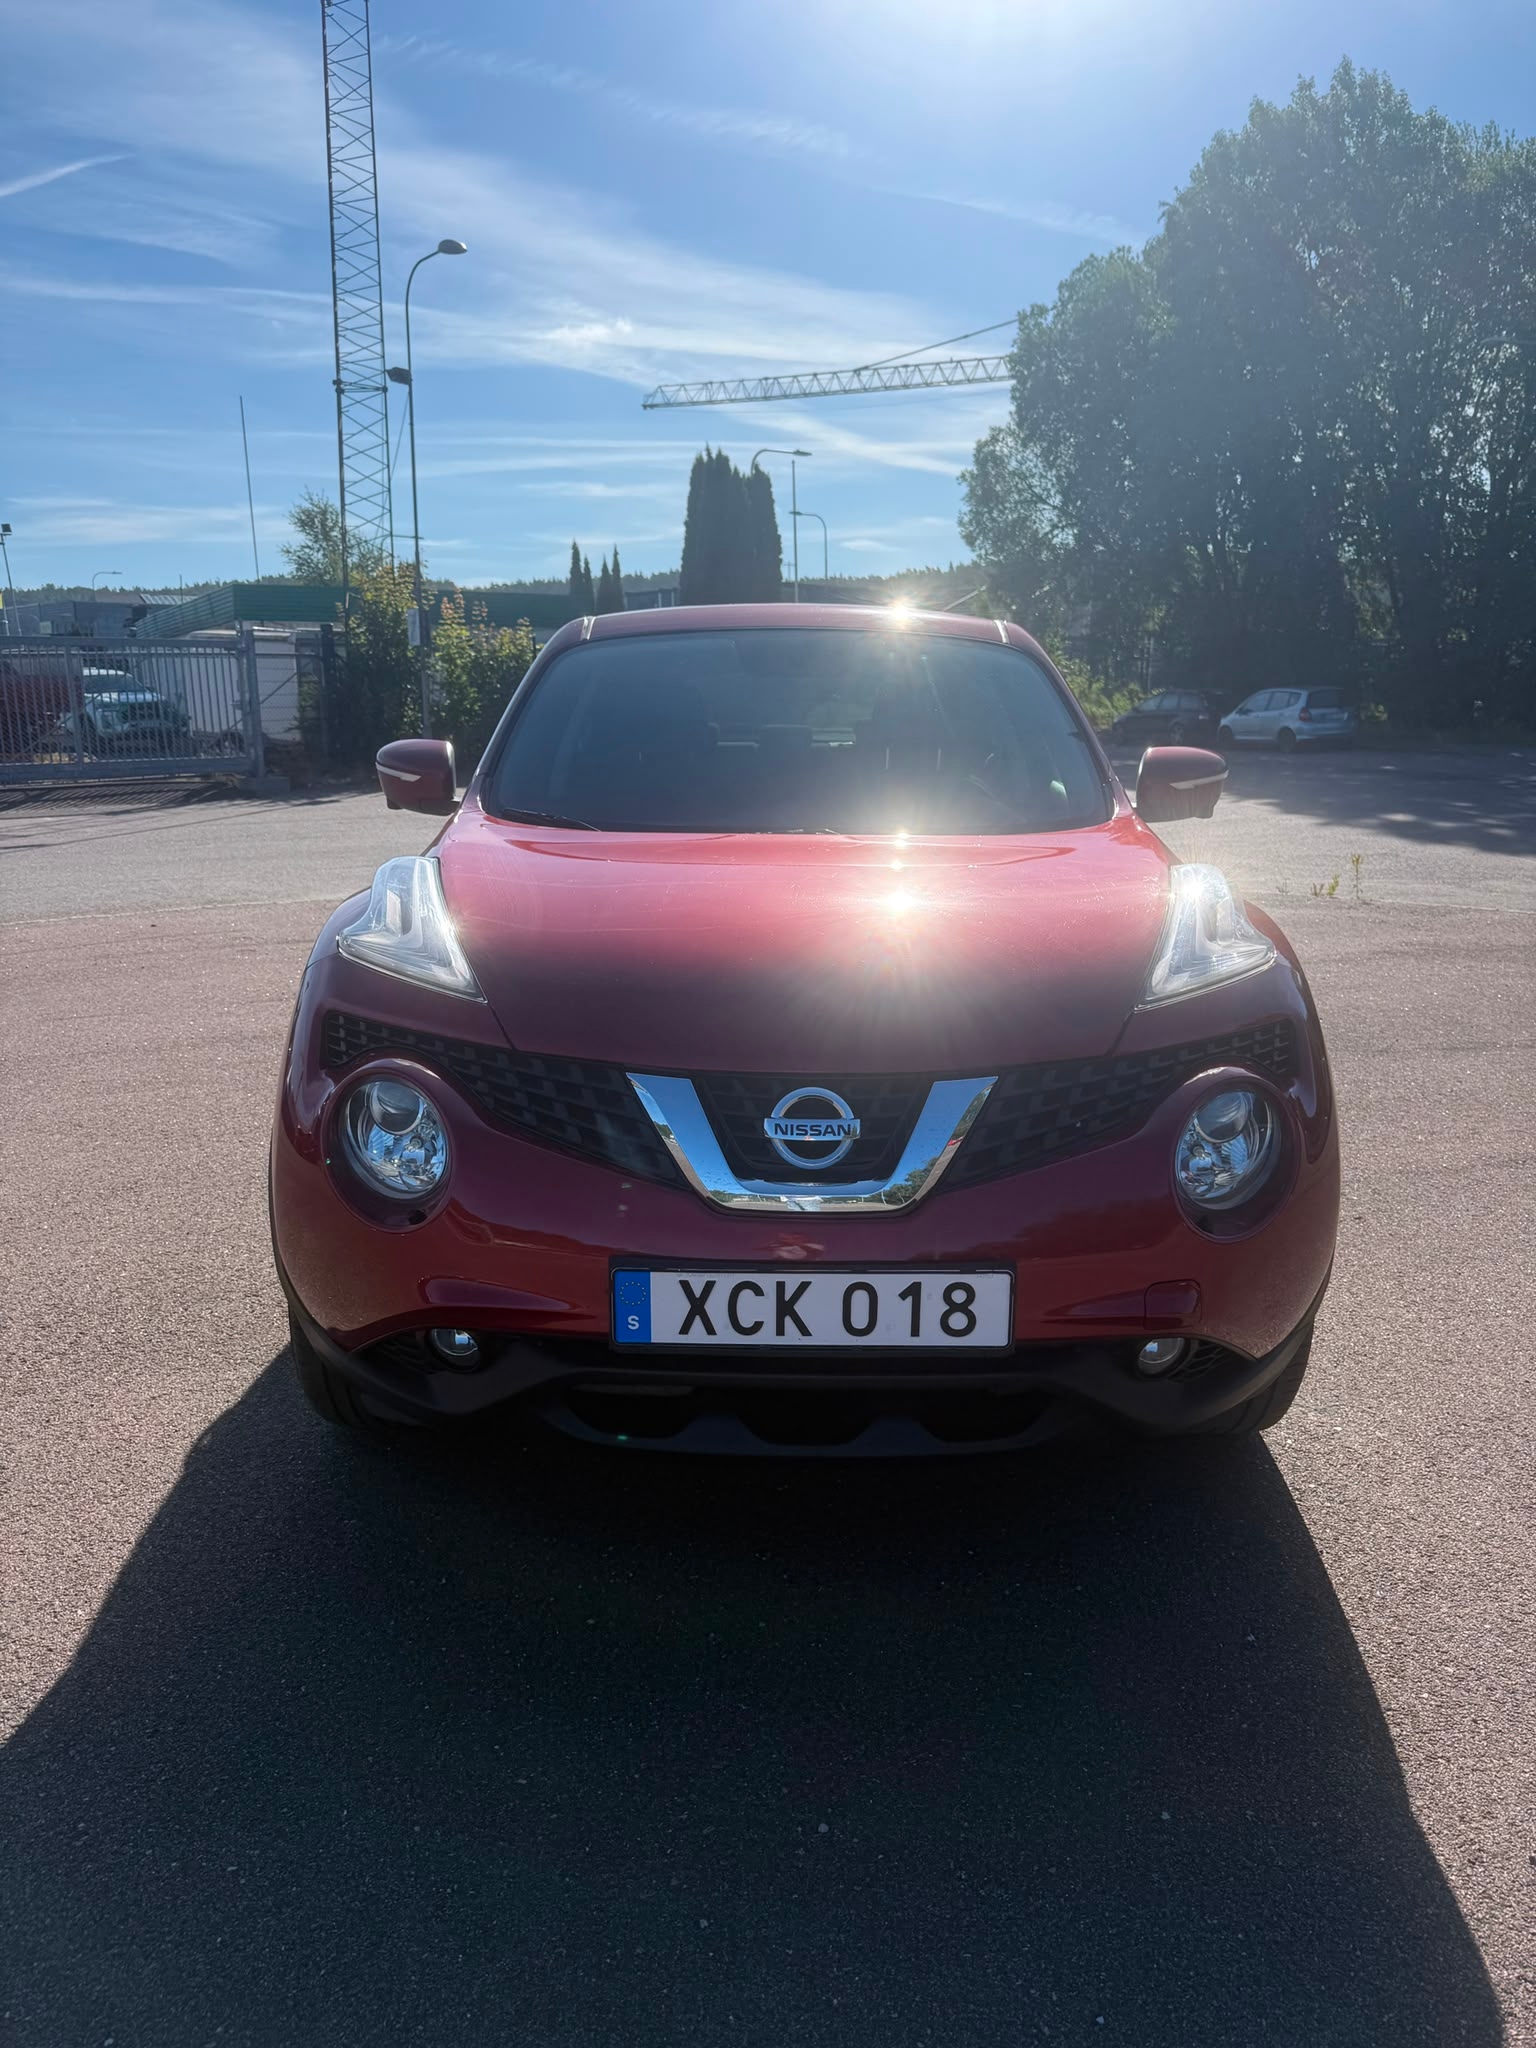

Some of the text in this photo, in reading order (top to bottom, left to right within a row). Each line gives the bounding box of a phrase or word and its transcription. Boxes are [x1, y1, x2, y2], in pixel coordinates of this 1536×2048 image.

[774, 1123, 851, 1137] NISSAN
[678, 1279, 977, 1338] XCK 018
[627, 1315, 640, 1330] S
